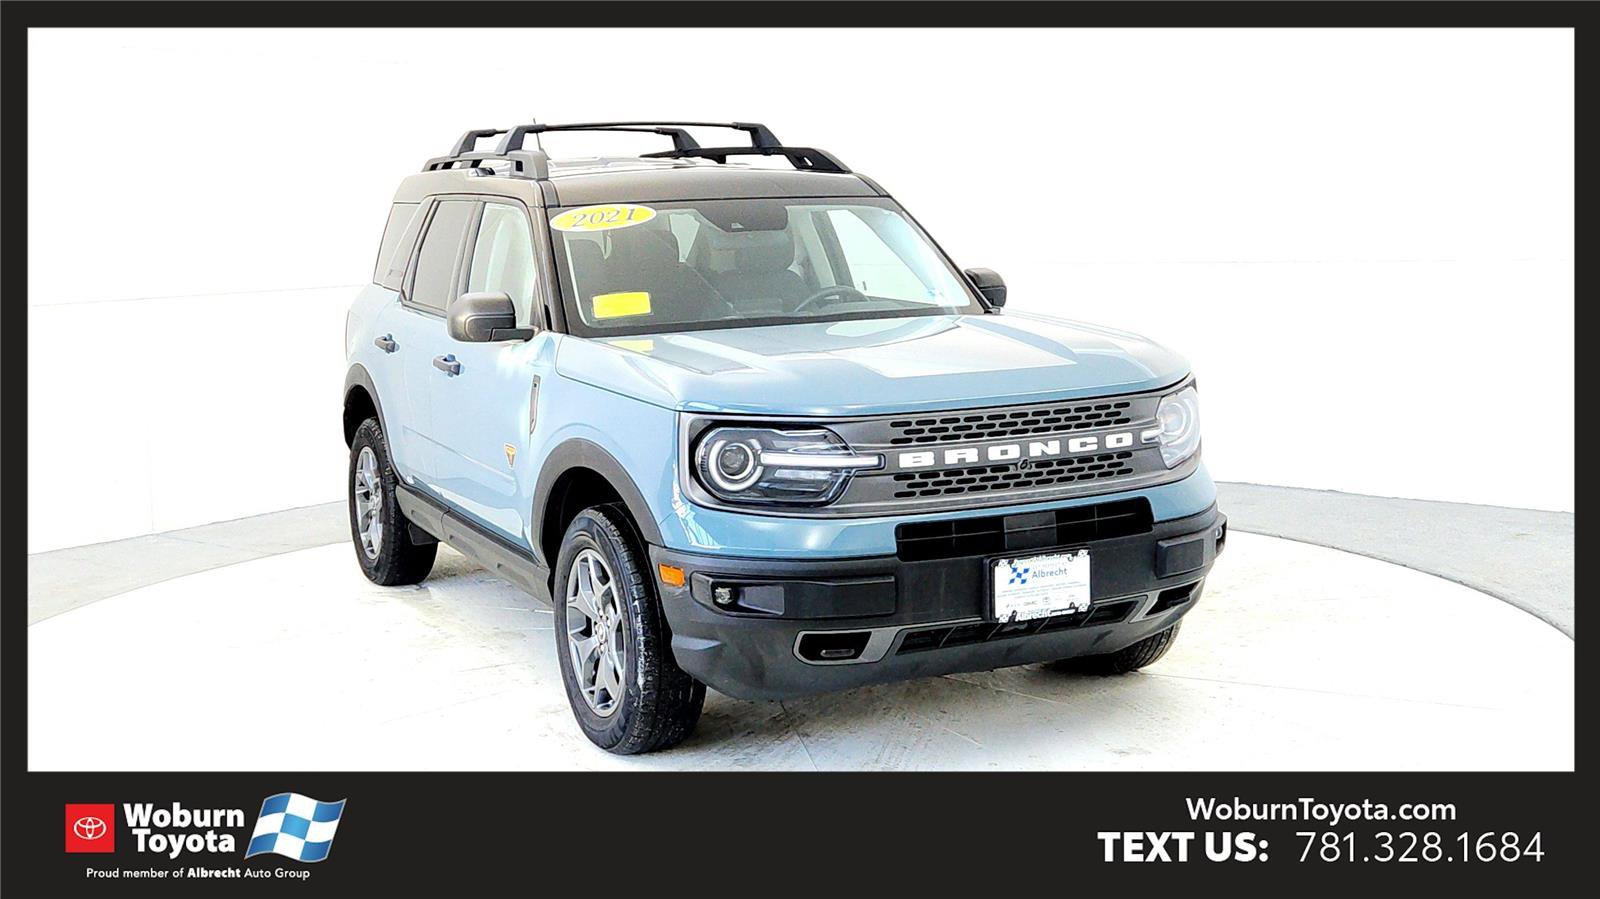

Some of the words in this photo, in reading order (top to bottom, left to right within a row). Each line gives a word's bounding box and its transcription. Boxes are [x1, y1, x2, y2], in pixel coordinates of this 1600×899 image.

[571, 208, 636, 228] 2021
[898, 432, 1133, 469] BRONCO
[1031, 567, 1068, 579] Albrecht
